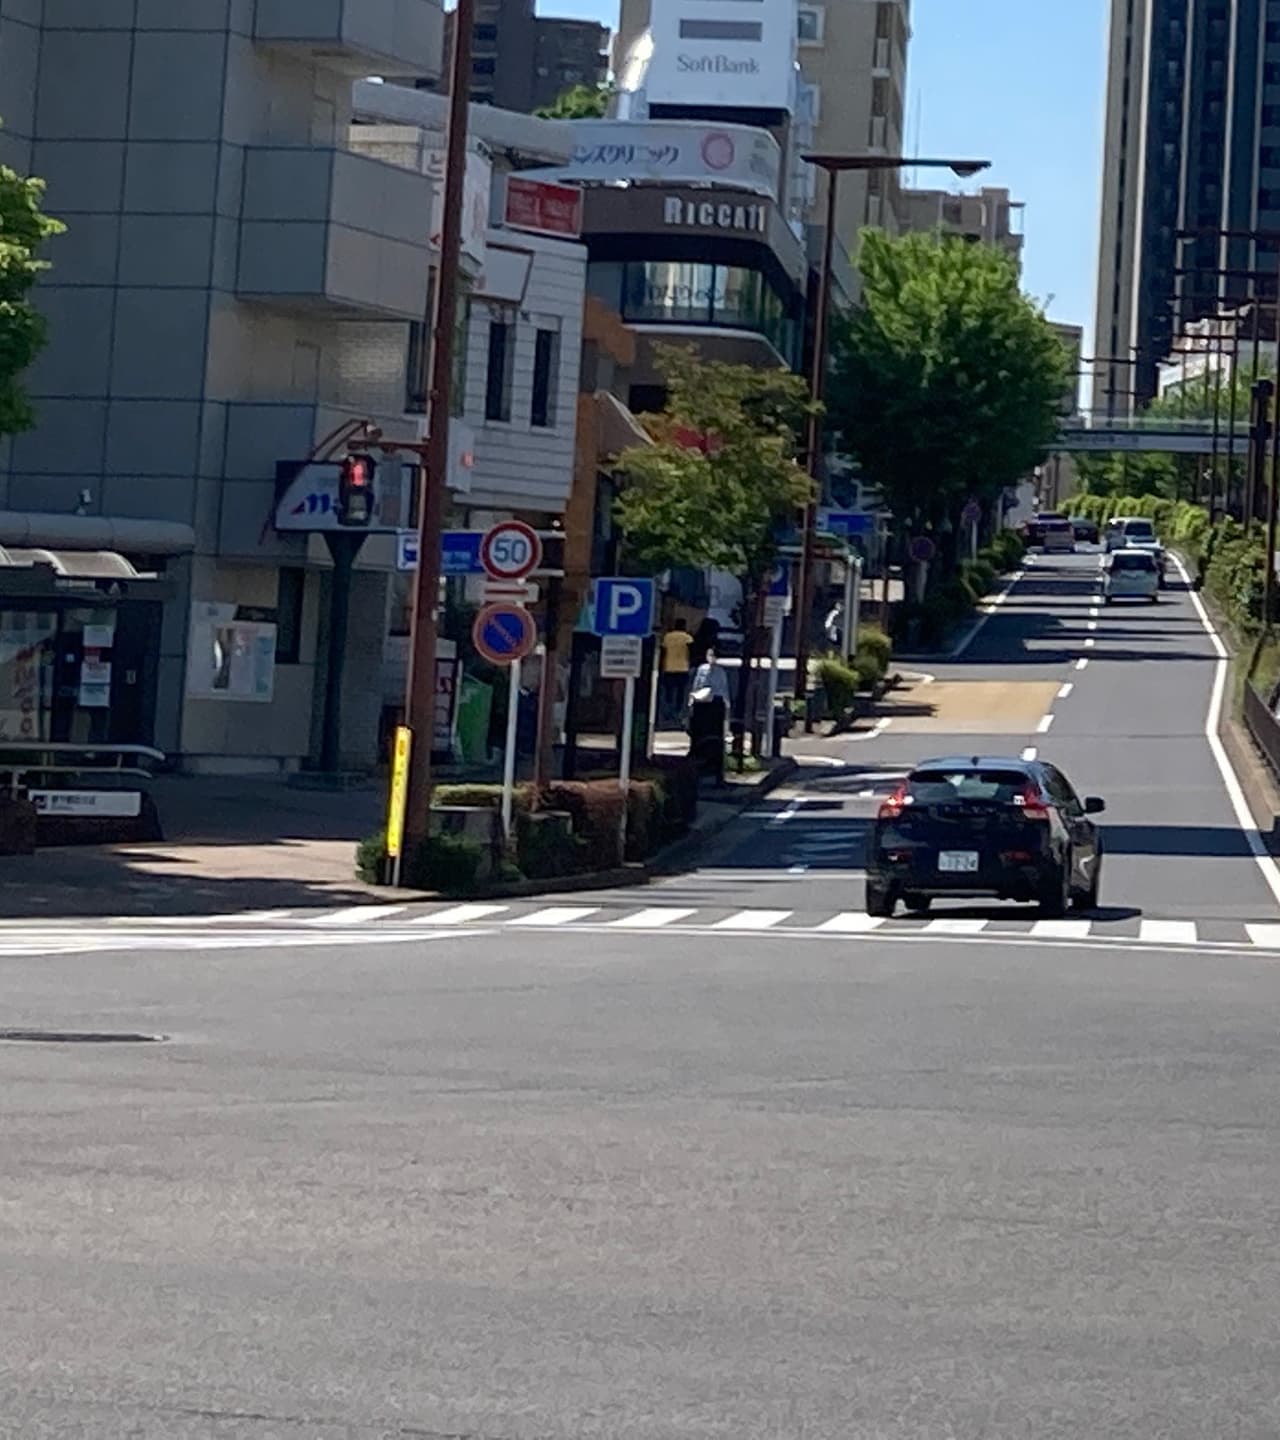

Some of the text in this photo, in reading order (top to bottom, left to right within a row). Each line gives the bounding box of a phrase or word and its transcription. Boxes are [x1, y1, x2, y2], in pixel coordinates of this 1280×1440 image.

[676, 53, 760, 75] SoftBank
[493, 537, 528, 564] 50
[609, 584, 642, 630] P
